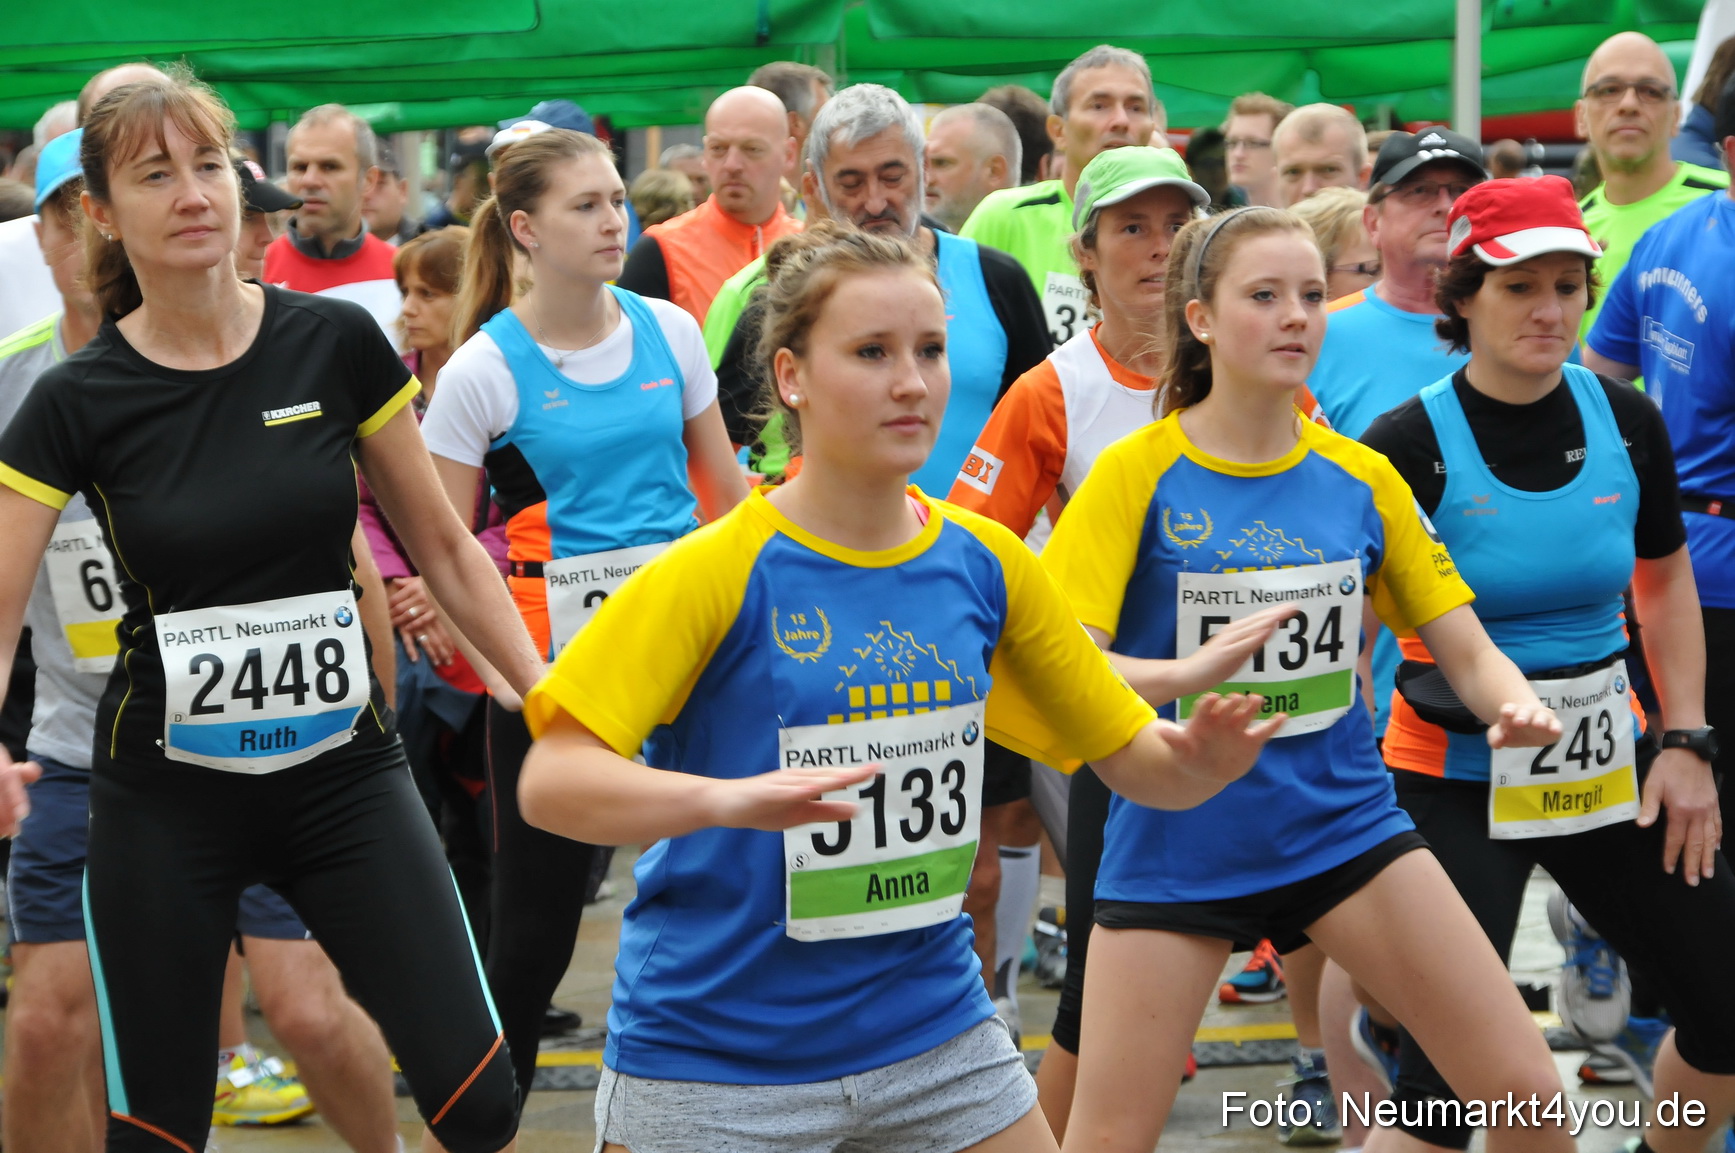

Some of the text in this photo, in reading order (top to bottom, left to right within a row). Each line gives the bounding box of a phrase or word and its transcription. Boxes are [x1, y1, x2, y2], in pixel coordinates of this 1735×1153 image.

[549, 568, 600, 588] PARTL
[1182, 582, 1333, 605] PARTL Neumarkt
[163, 613, 327, 648] PARTL Neumarkt
[790, 612, 807, 625] 15
[784, 628, 820, 642] Jahre
[189, 637, 350, 716] 2448
[1246, 690, 1299, 713] ena
[1562, 685, 1613, 709] Neumarkt
[239, 725, 297, 752] Ruth
[786, 730, 956, 768] PARTL Neumarkt
[1541, 784, 1604, 813] Margit
[865, 870, 930, 903] Anna
